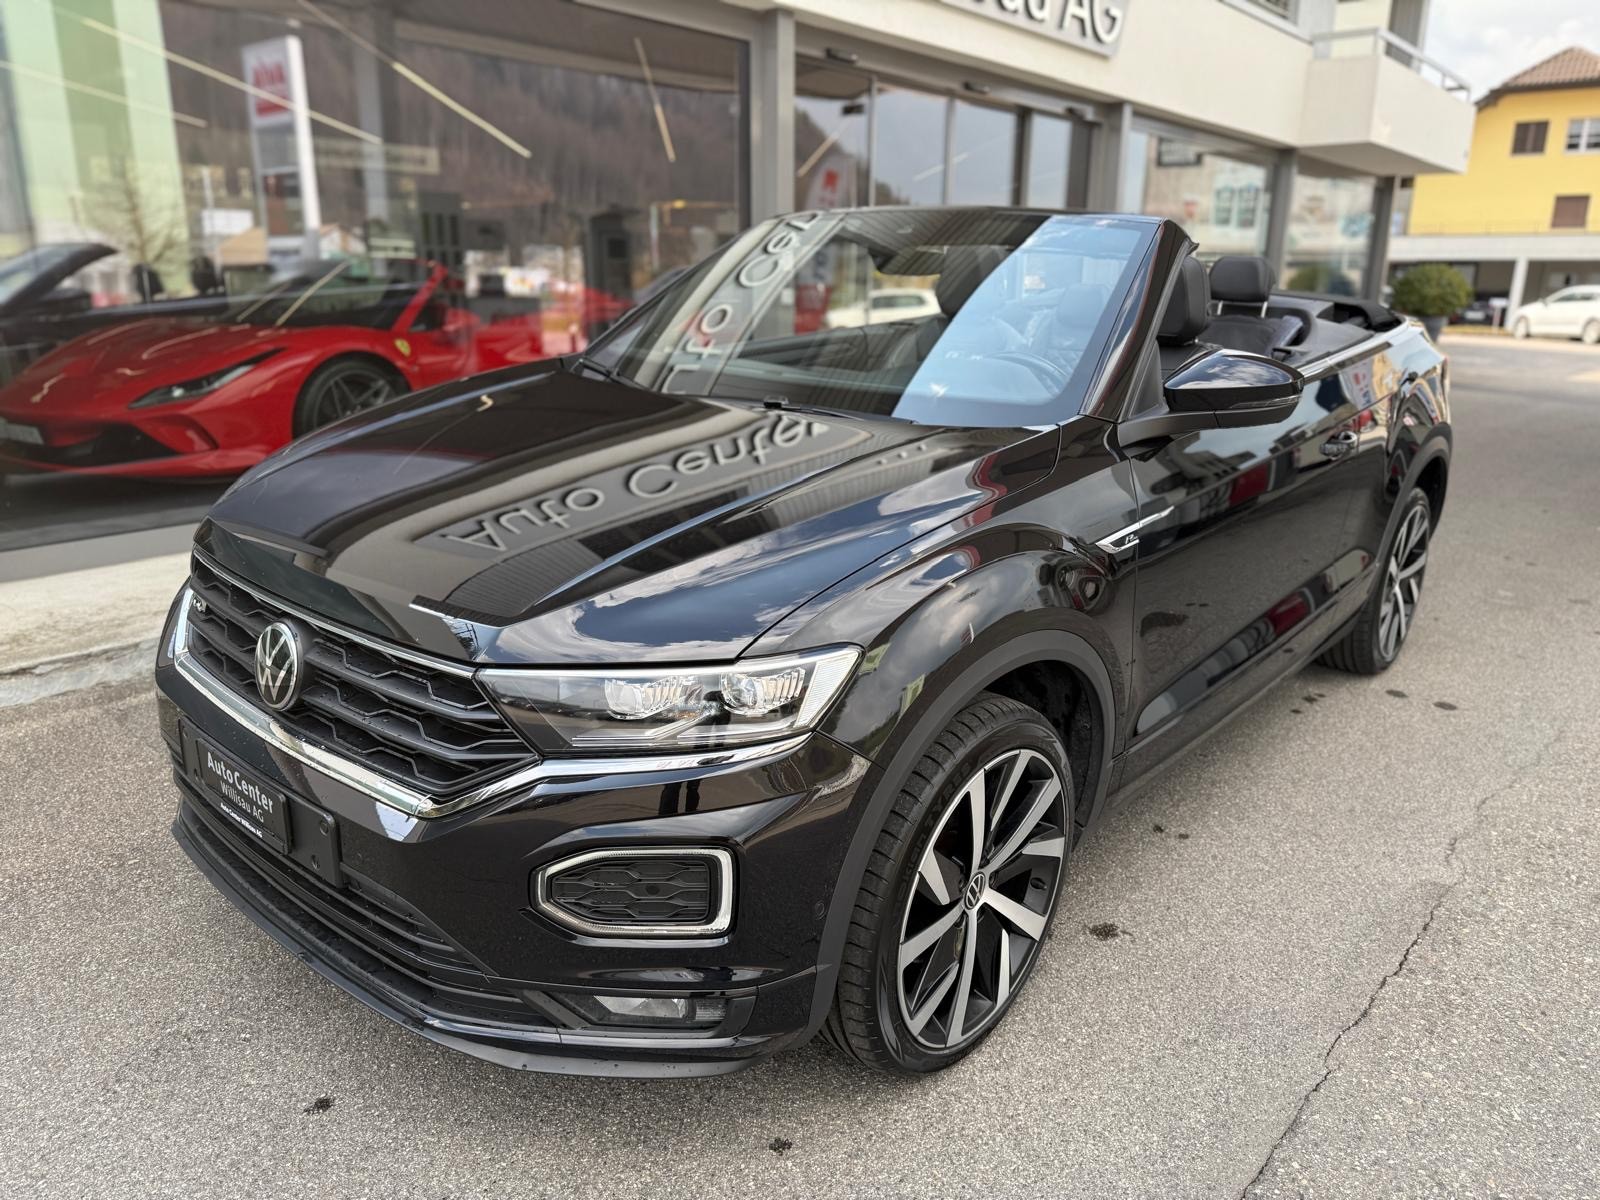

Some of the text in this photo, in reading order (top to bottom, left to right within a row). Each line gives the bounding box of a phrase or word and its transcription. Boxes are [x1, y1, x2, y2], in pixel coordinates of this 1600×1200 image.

[1058, 0, 1123, 44] AG
[220, 780, 265, 823] Willisau AG
